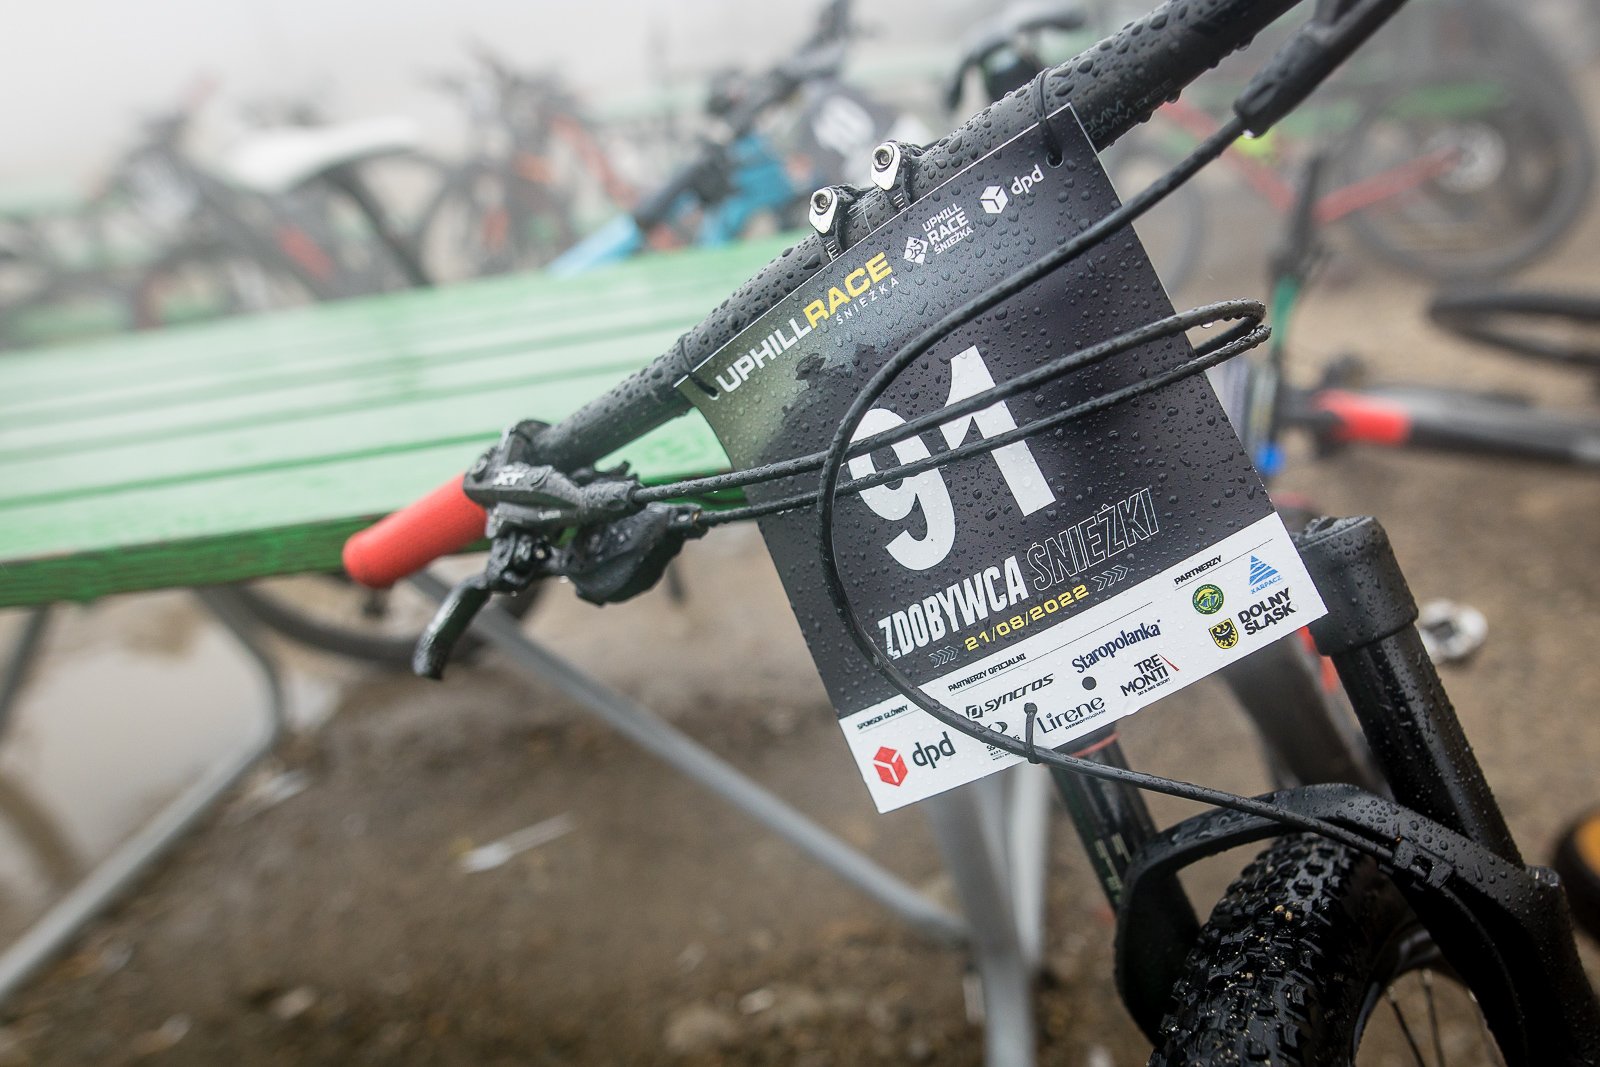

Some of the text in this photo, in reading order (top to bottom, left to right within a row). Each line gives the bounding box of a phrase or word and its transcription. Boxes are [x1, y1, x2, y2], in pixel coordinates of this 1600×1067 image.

[1010, 164, 1044, 196] dpd
[922, 203, 963, 232] UPHILL
[927, 211, 969, 246] RACE
[934, 225, 974, 255] ŚNIEŻKA
[836, 277, 900, 325] ŚNIEŻKA
[847, 345, 1057, 571] 91
[877, 488, 1160, 661] ZDOBYWCA ŚNIEŻKI
[1174, 554, 1222, 585] PARTNERZY
[1250, 575, 1283, 595] KARPACZ
[964, 584, 1090, 651] 21/08/2022
[1237, 587, 1291, 624] DOLNY
[1071, 622, 1161, 674] Staropolanka
[1133, 653, 1163, 675] TRE
[948, 669, 988, 692] PARTNERZY
[984, 673, 1054, 712] syncros
[1120, 665, 1169, 697] MONTI
[1036, 697, 1105, 734] Lirene
[912, 730, 956, 769] dpd
